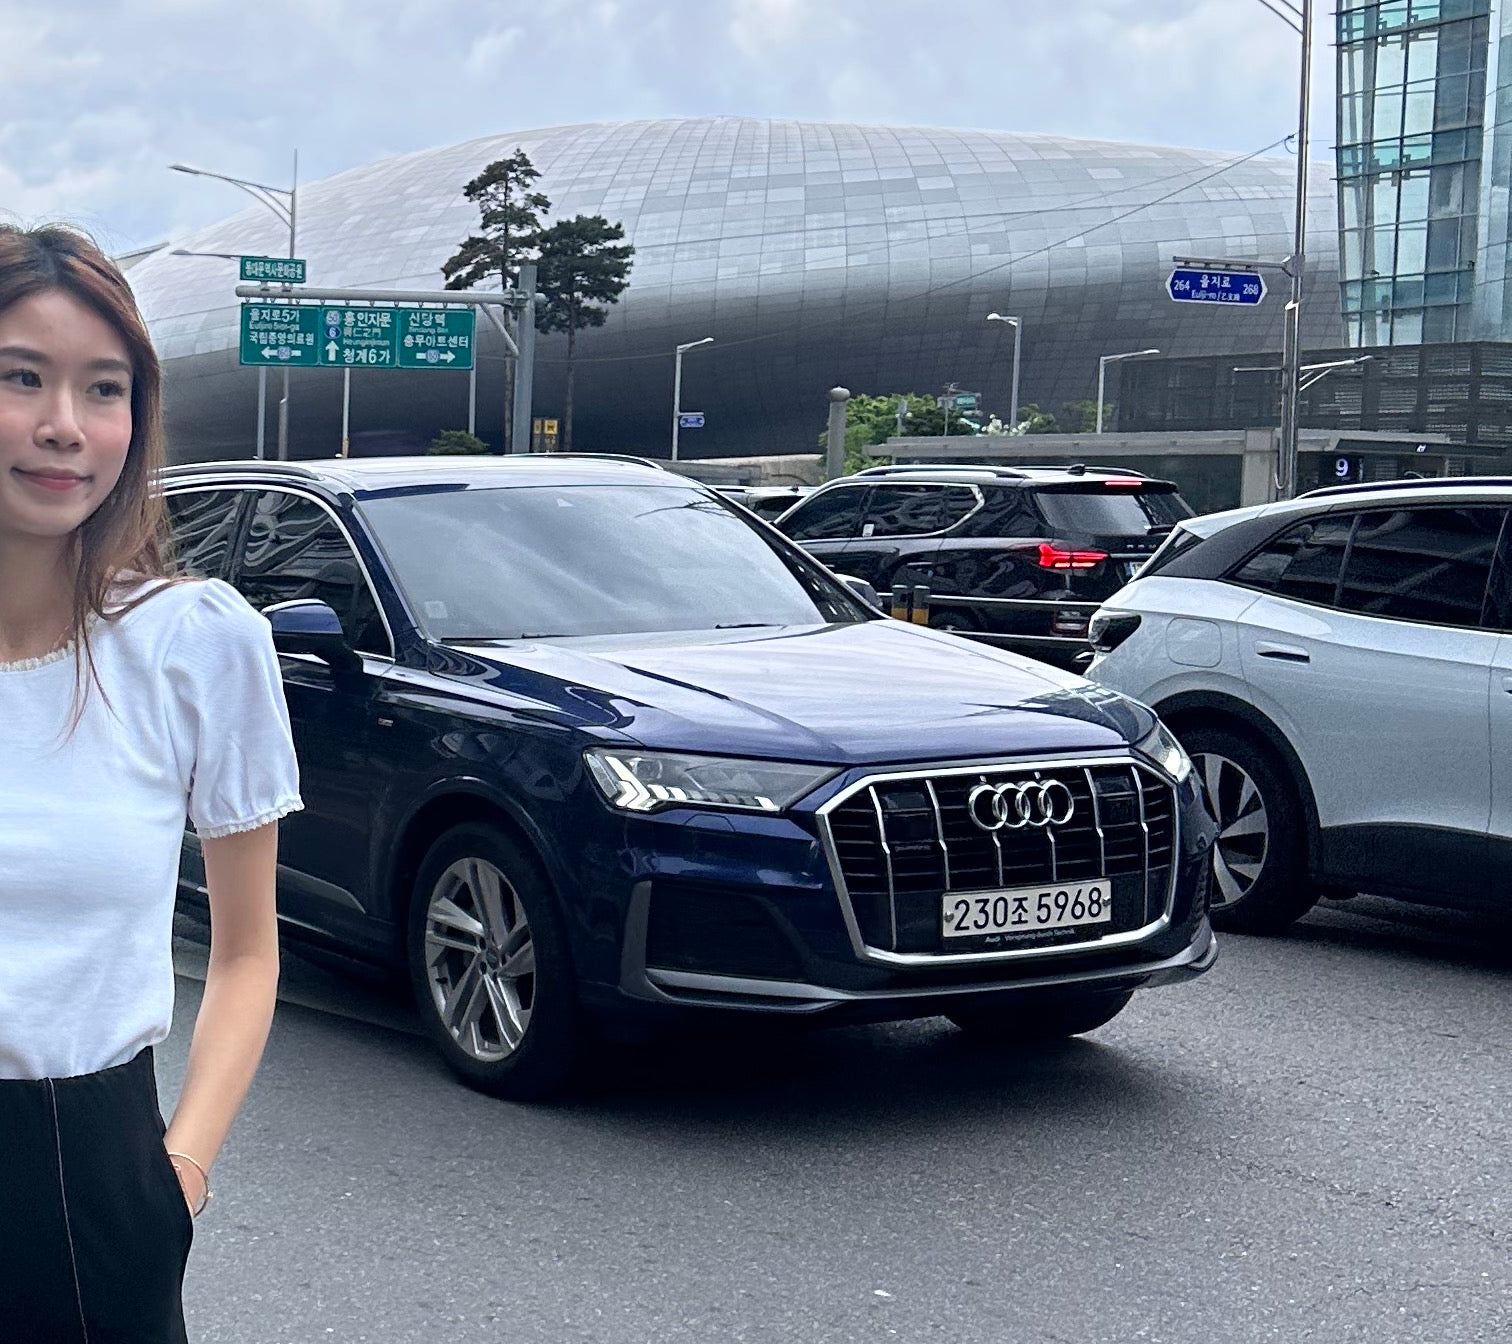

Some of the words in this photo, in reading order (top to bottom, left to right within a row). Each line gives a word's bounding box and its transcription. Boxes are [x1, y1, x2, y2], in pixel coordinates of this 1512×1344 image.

[1200, 274, 1232, 289] 을지로
[249, 308, 300, 322] 을지로5가
[343, 311, 392, 327] 흥인지문
[409, 312, 445, 326] 신당역
[249, 331, 314, 346] 국립중앙의료원
[404, 335, 469, 348] 충무아트센터
[343, 348, 390, 364] 청계6가
[1335, 458, 1349, 477] 9
